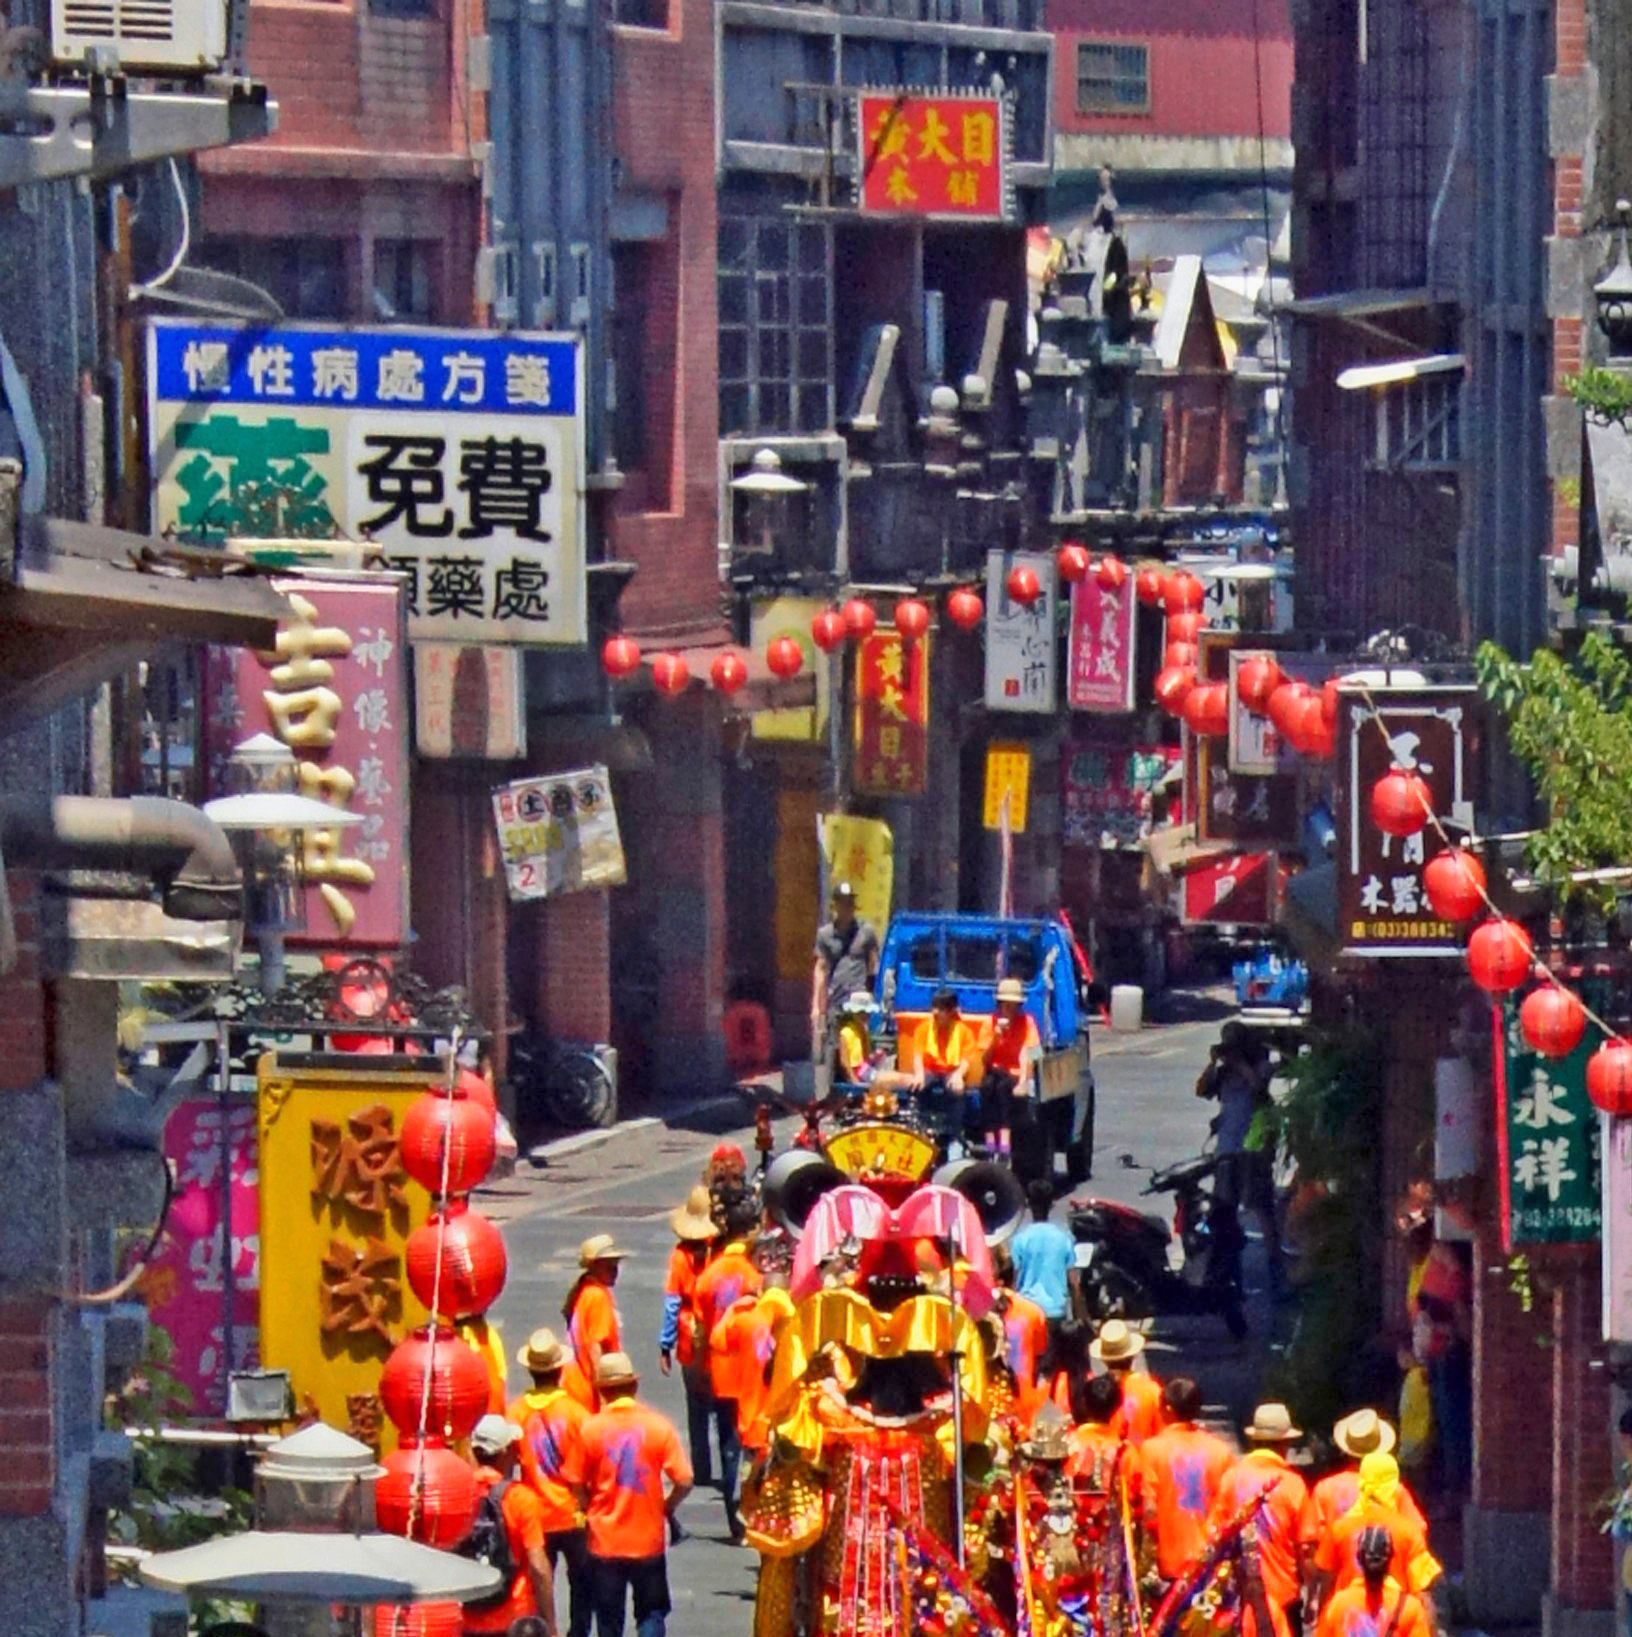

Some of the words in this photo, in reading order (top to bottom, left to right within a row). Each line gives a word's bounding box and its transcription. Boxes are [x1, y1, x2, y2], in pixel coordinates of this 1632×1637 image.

[183, 341, 552, 406] 慢性病處方箋
[358, 436, 552, 543] 免費
[1361, 874, 1433, 915] 木器
